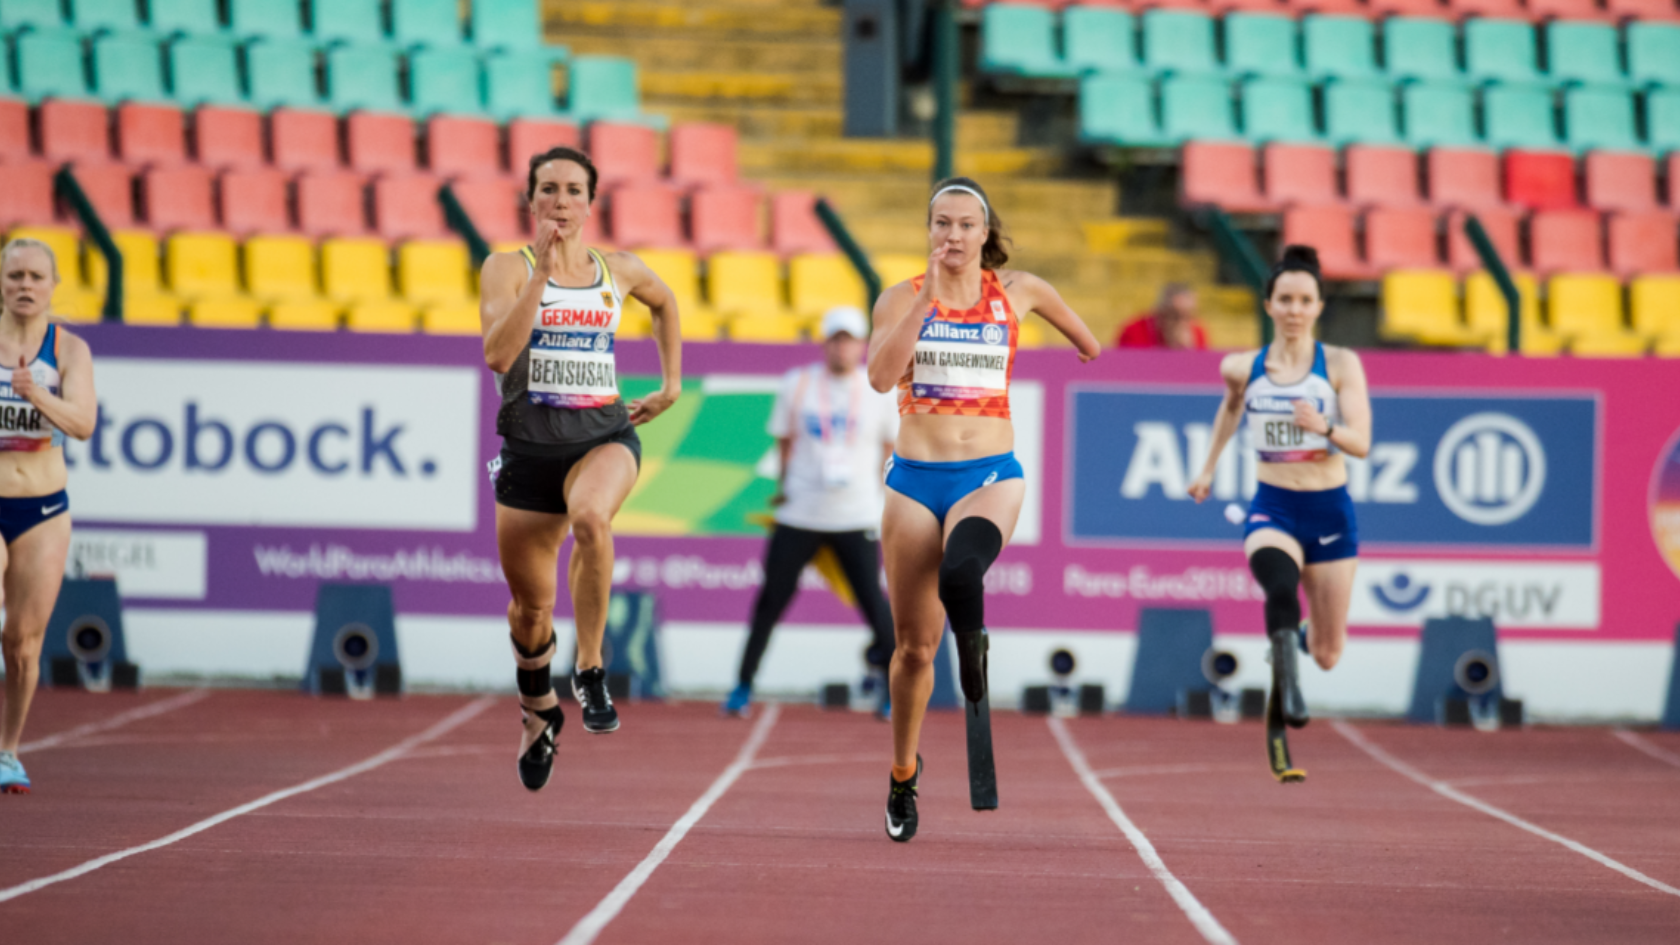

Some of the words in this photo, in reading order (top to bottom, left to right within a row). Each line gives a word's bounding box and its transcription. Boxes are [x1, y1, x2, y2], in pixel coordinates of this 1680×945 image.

[541, 308, 613, 328] GERMANY
[538, 333, 592, 349] Allianz
[921, 322, 980, 340] Allianz
[915, 350, 937, 366] VAN
[939, 351, 1005, 371] GANSEWINKEL
[531, 358, 614, 388] BENSUSAN
[1265, 421, 1304, 447] REID
[1446, 581, 1563, 619] DGUV
